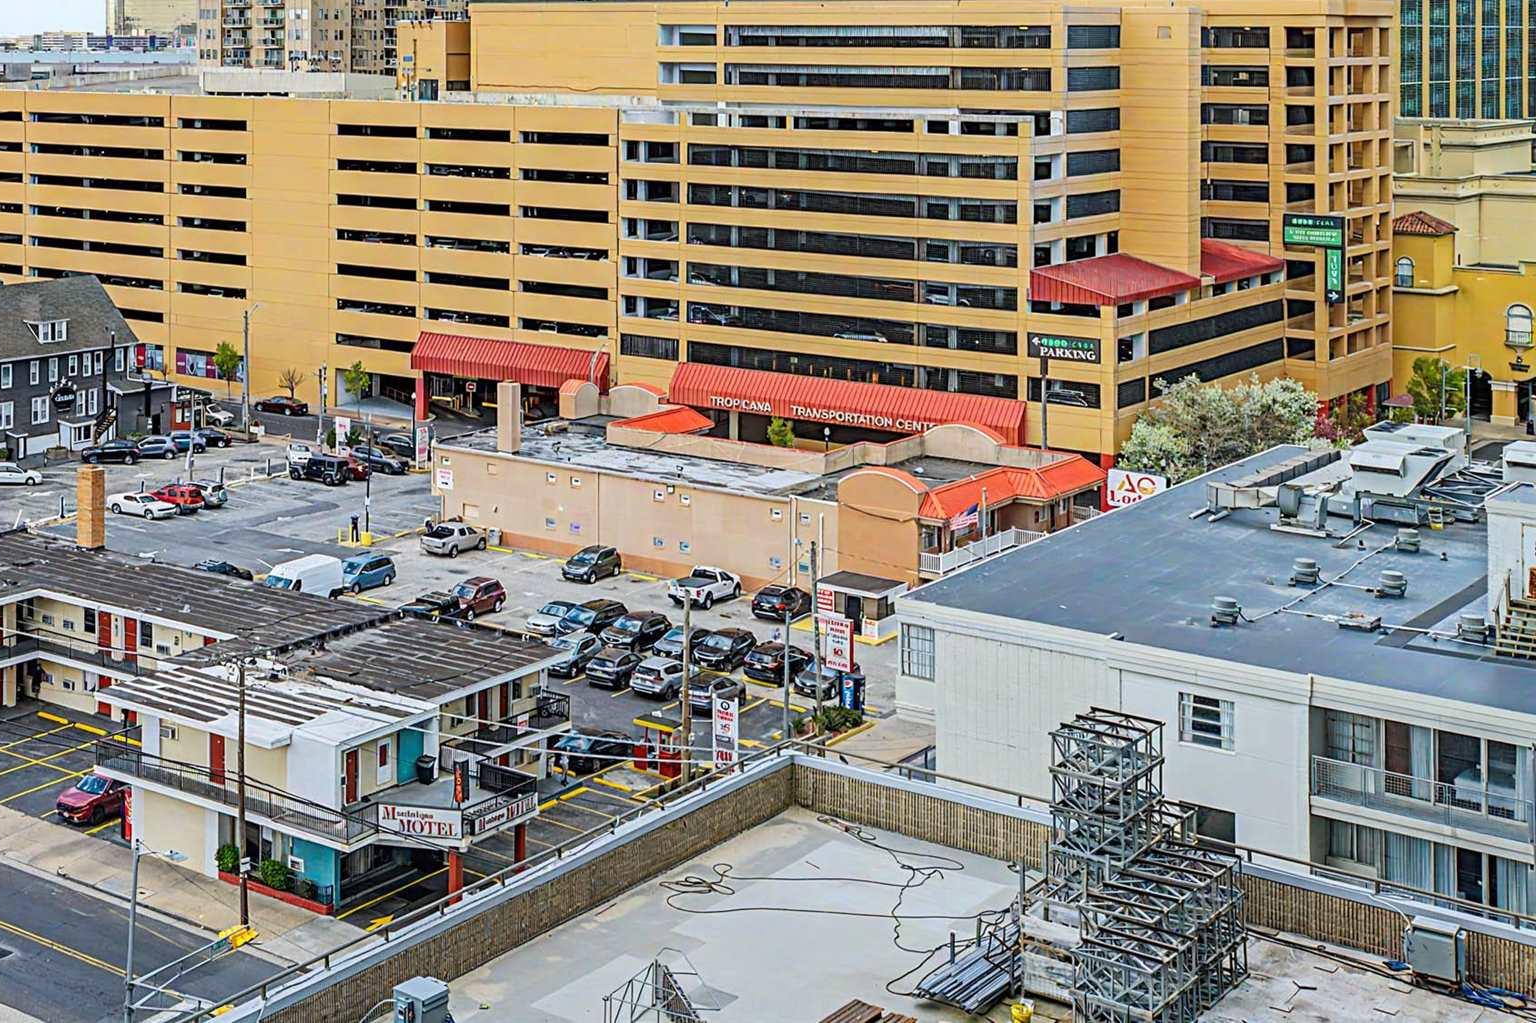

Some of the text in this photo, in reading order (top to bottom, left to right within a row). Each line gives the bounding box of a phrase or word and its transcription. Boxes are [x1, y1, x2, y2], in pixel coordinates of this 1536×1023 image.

[1039, 346, 1096, 361] PARKING
[710, 396, 935, 432] TROPICANA TRANSPORTATION CENT
[399, 819, 458, 837] MOTEL
